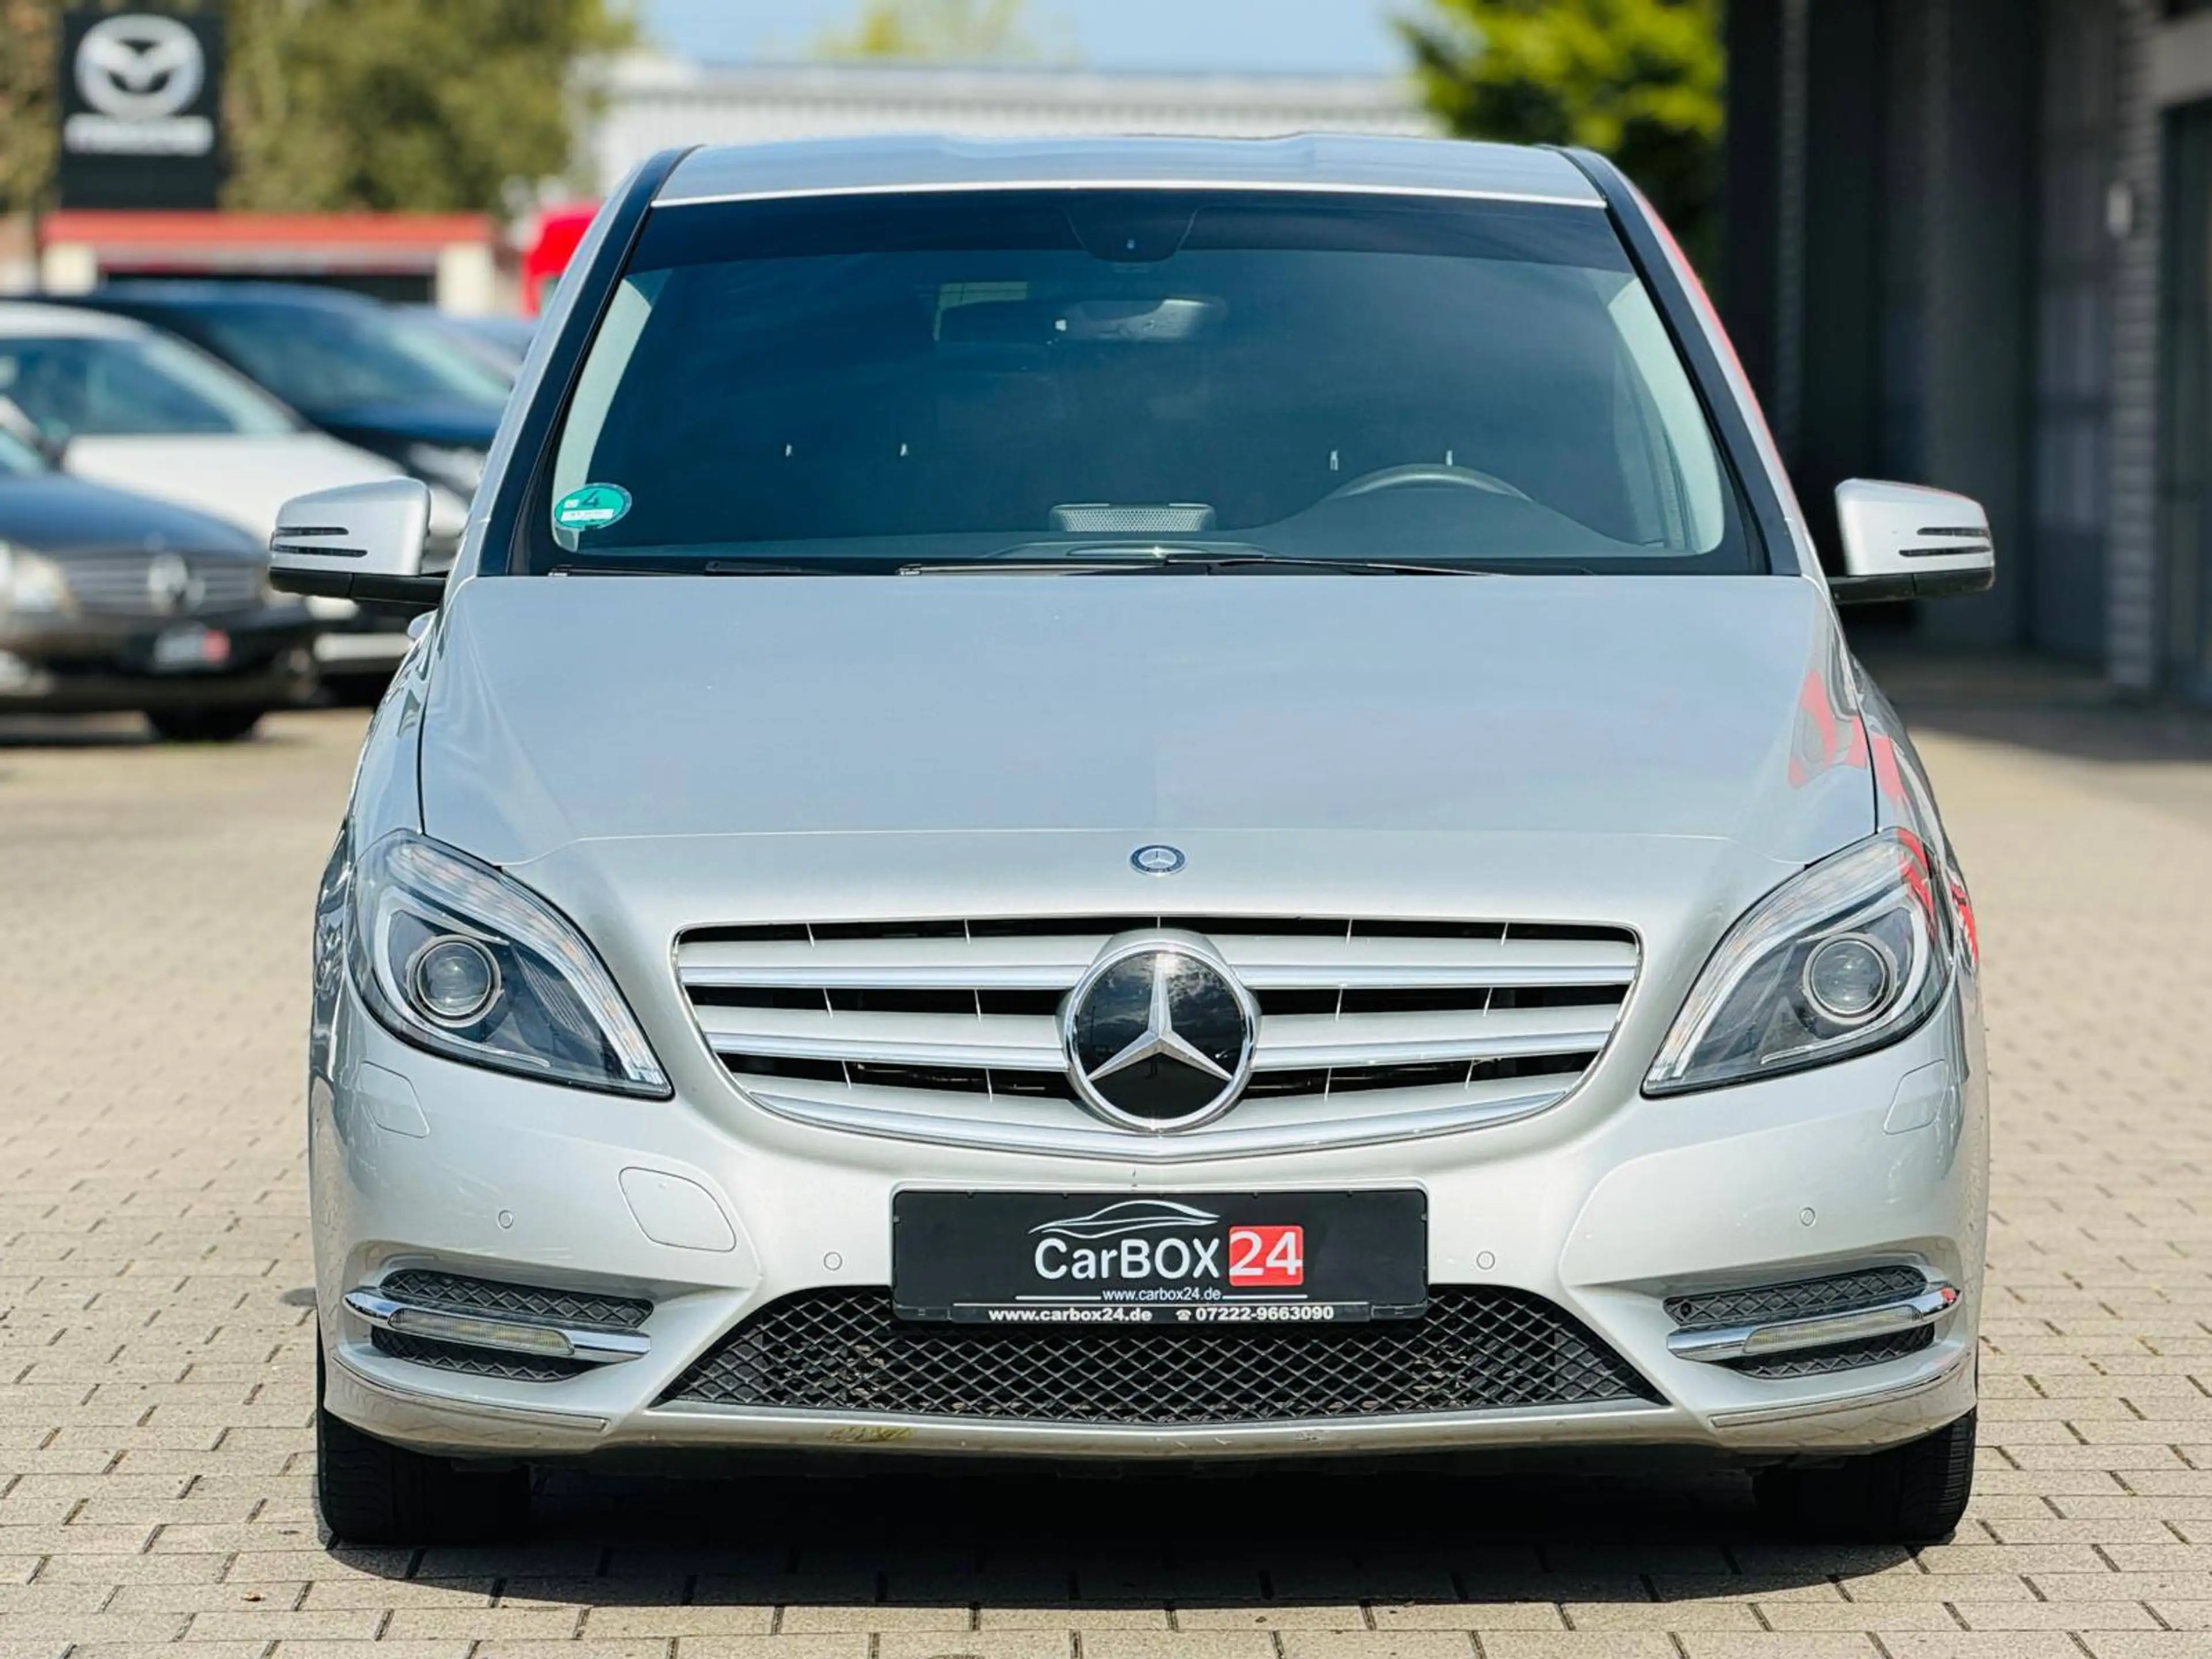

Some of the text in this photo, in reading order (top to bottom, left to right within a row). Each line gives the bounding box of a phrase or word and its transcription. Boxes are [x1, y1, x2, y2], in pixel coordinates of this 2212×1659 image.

[1102, 1287, 1222, 1301] www.carbox24.de
[988, 1305, 1335, 1321] www.carbox24.de 07222-9663090
